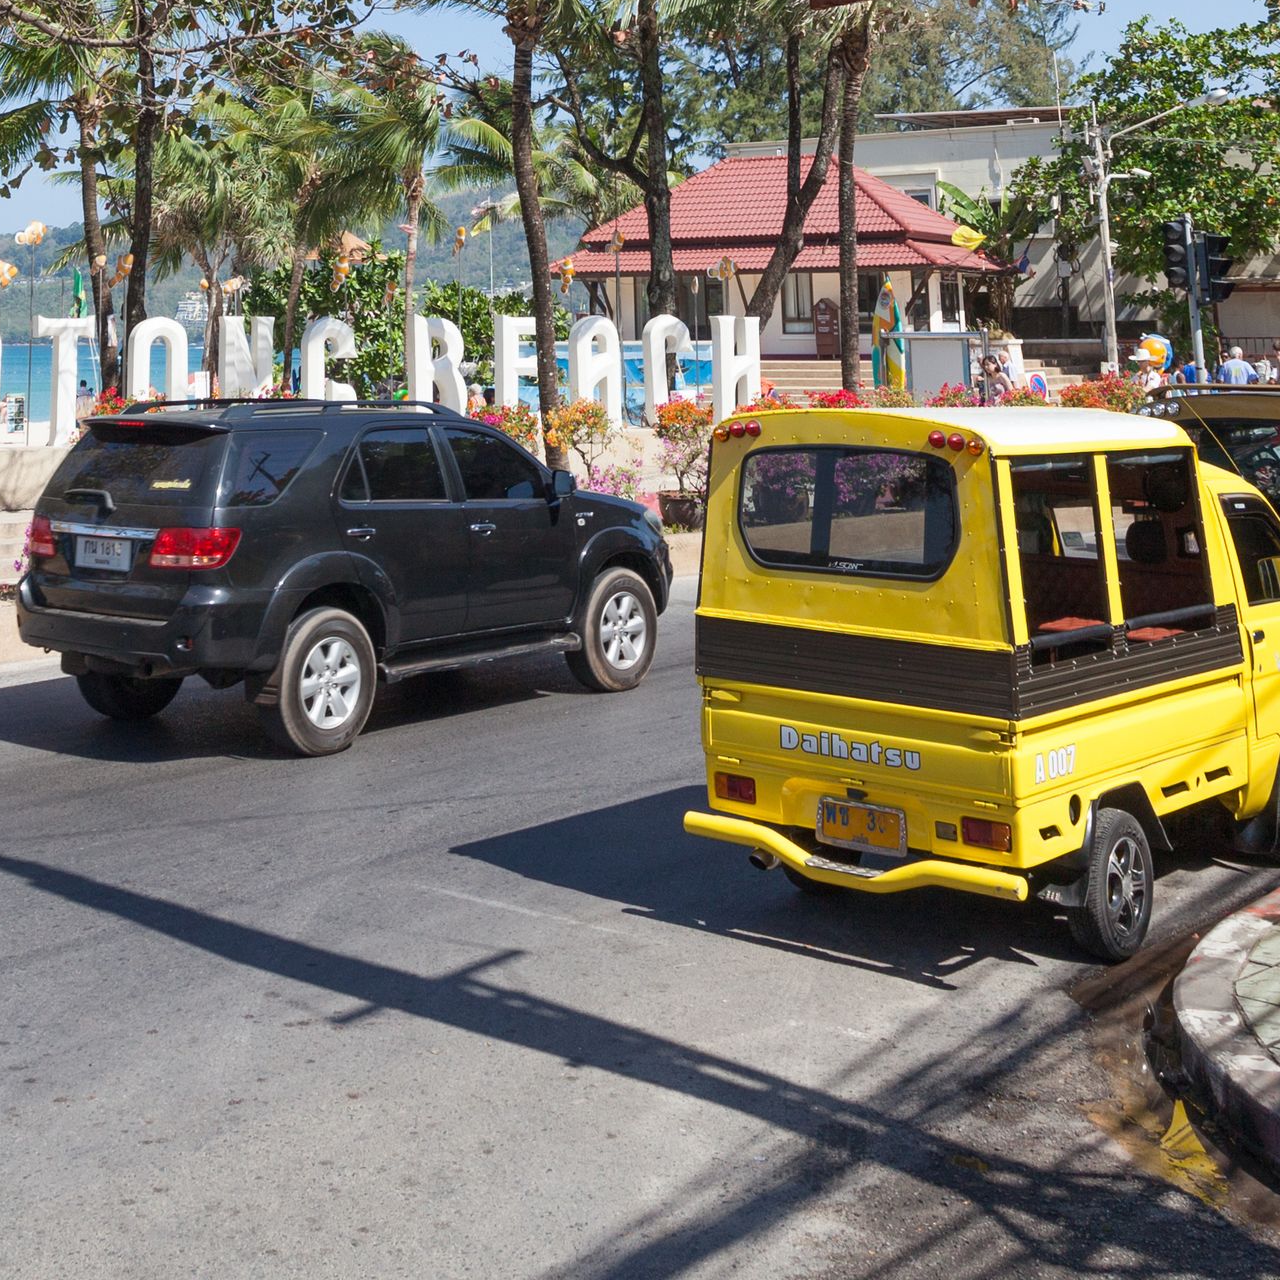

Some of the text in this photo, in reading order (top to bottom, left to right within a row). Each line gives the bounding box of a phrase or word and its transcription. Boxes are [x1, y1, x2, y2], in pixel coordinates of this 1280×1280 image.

[780, 724, 922, 771] Daihatsu
[1035, 743, 1075, 784] A 007
